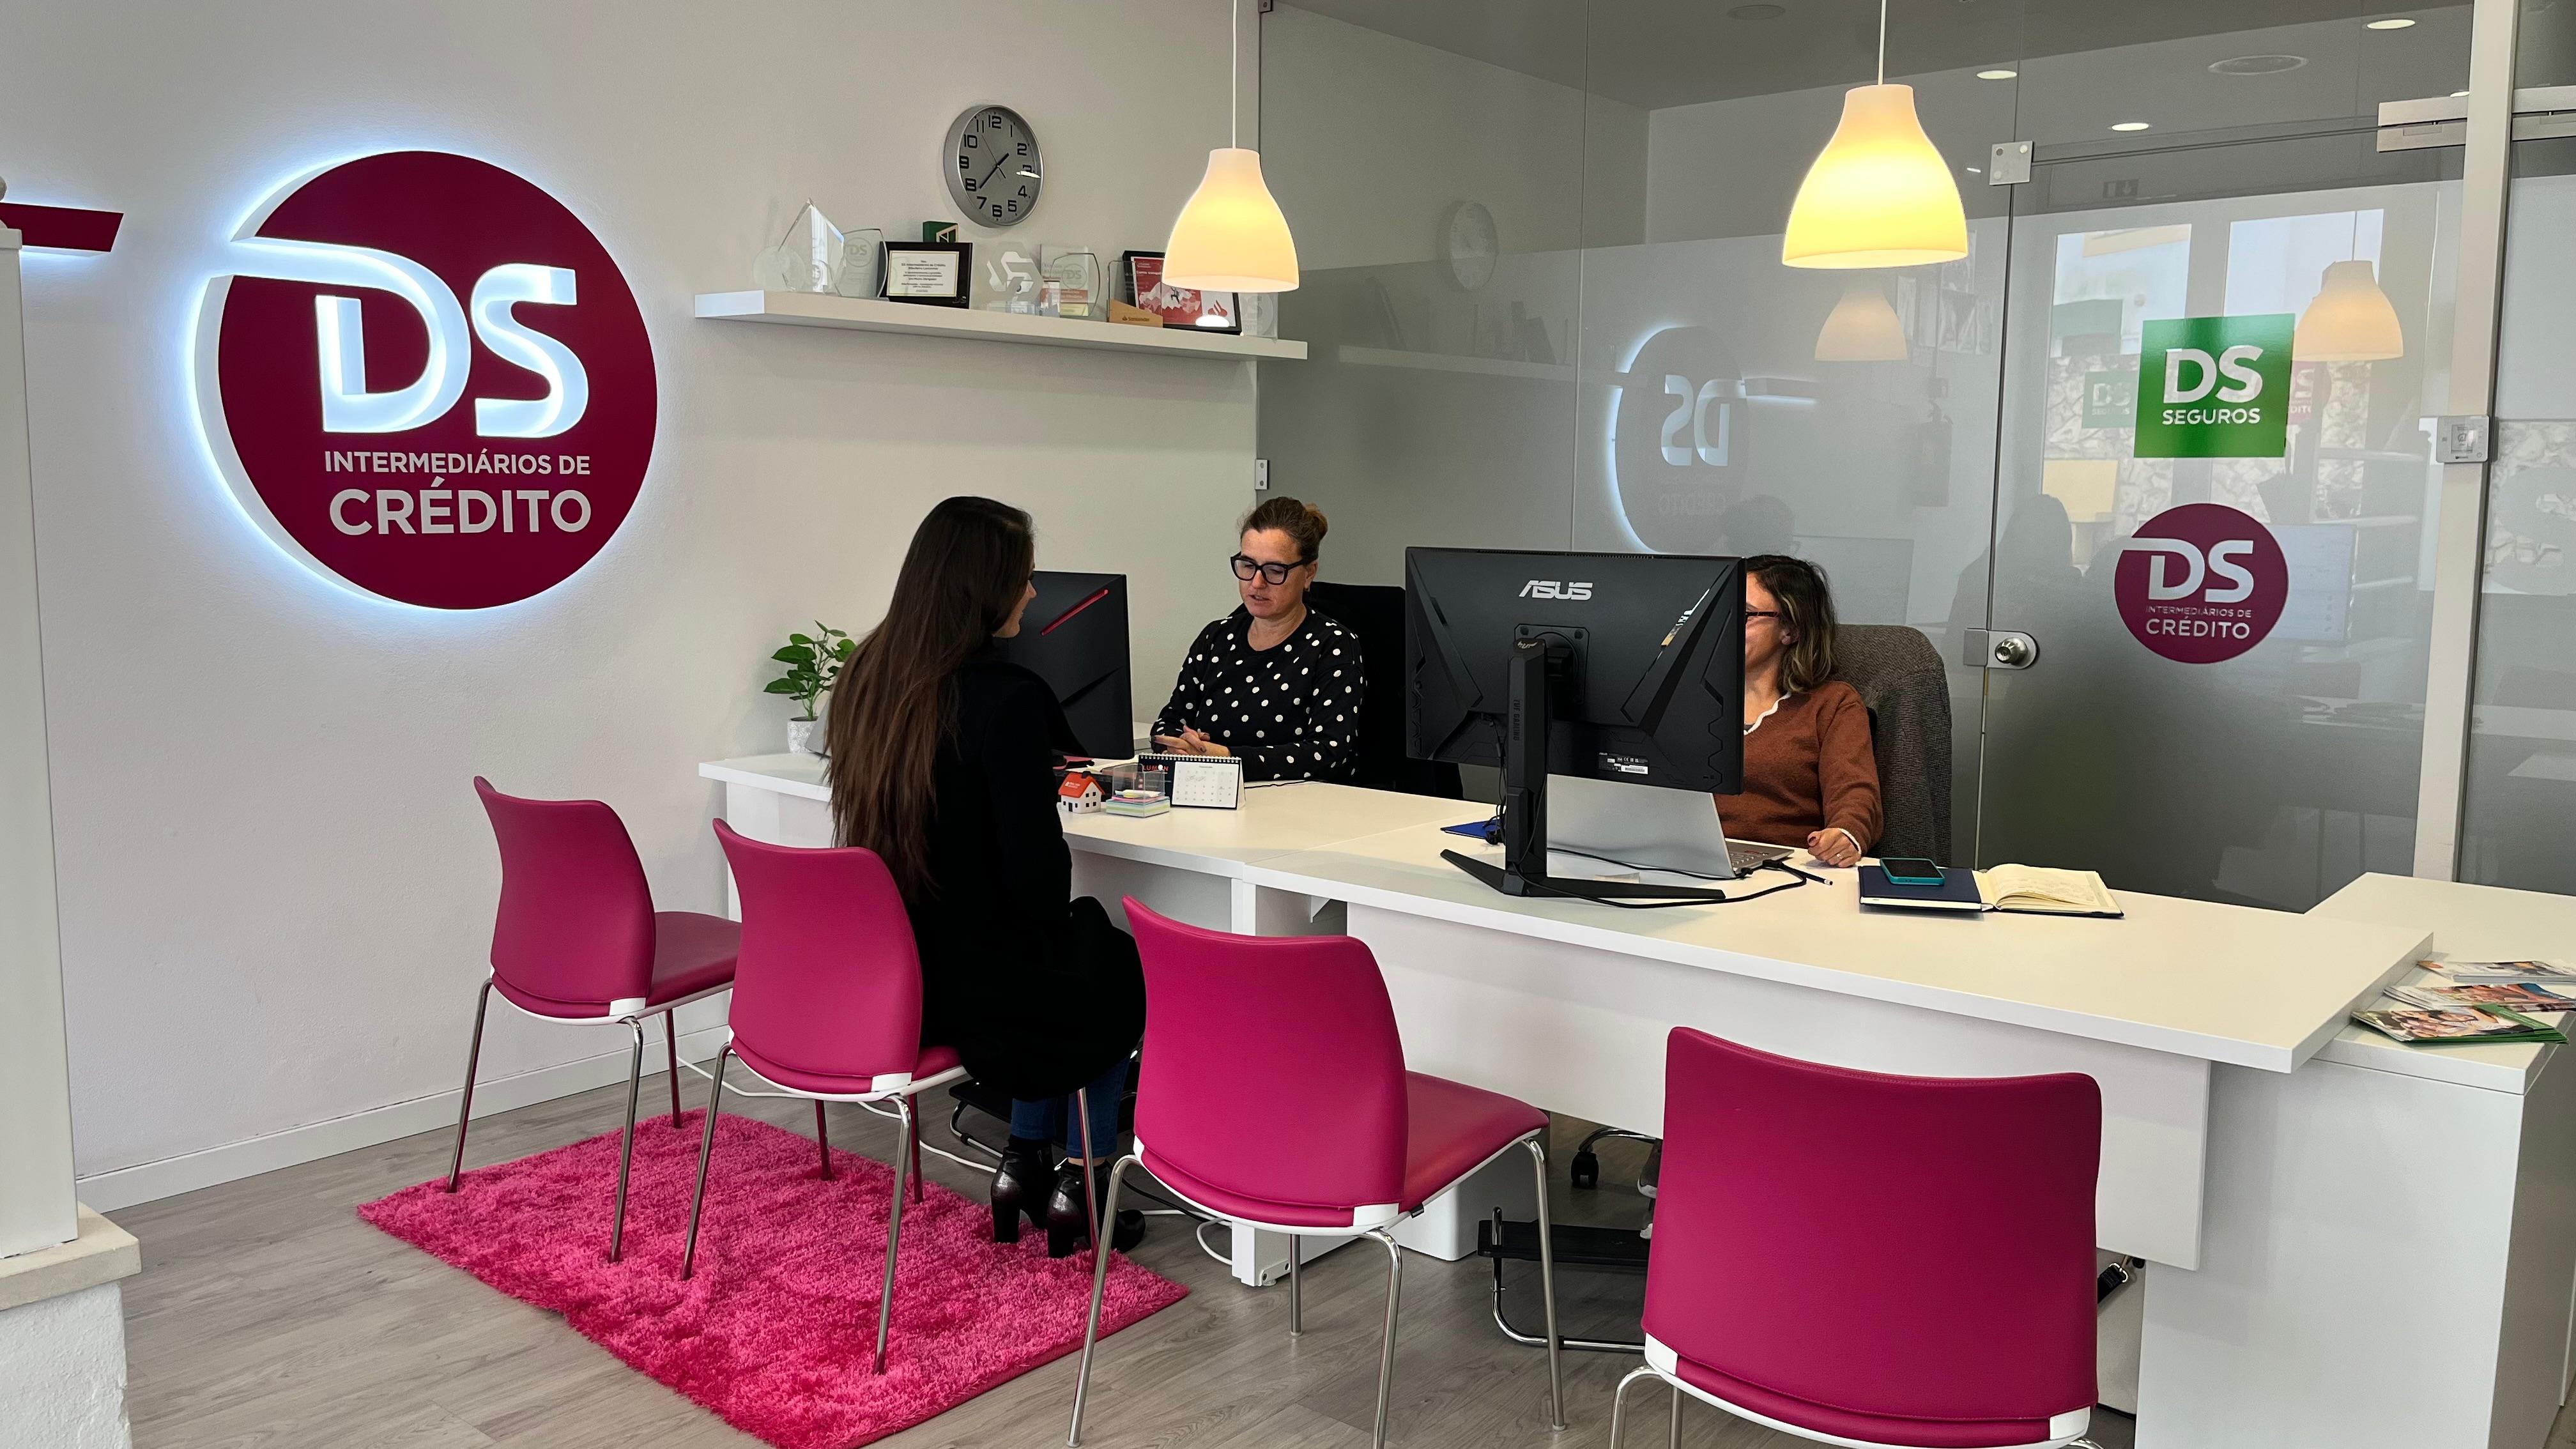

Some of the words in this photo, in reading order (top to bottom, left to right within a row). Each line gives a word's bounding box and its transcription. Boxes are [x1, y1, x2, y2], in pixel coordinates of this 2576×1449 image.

[976, 119, 985, 133] 11
[988, 115, 1002, 129] 12
[963, 134, 978, 148] 10
[1016, 142, 1027, 156] 2
[959, 155, 969, 169] 9
[965, 178, 977, 192] 8
[1018, 185, 1027, 198] 4
[976, 196, 987, 210] 7
[1008, 199, 1017, 212] 5
[992, 204, 1002, 218] 6
[230, 235, 588, 438] DS
[2163, 345, 2264, 404] DS
[2162, 408, 2260, 425] SEGUROS
[325, 448, 552, 475] INTERMEDIÁRIOS
[559, 455, 591, 475] DE
[330, 476, 592, 535] CRÉDITO
[2124, 537, 2255, 603] DS
[1519, 579, 1593, 601] ASUS
[2146, 605, 2234, 617] INTERMEDIÁRIOS
[2237, 610, 2252, 618] DE
[2145, 615, 2250, 640] CRÉDITO
